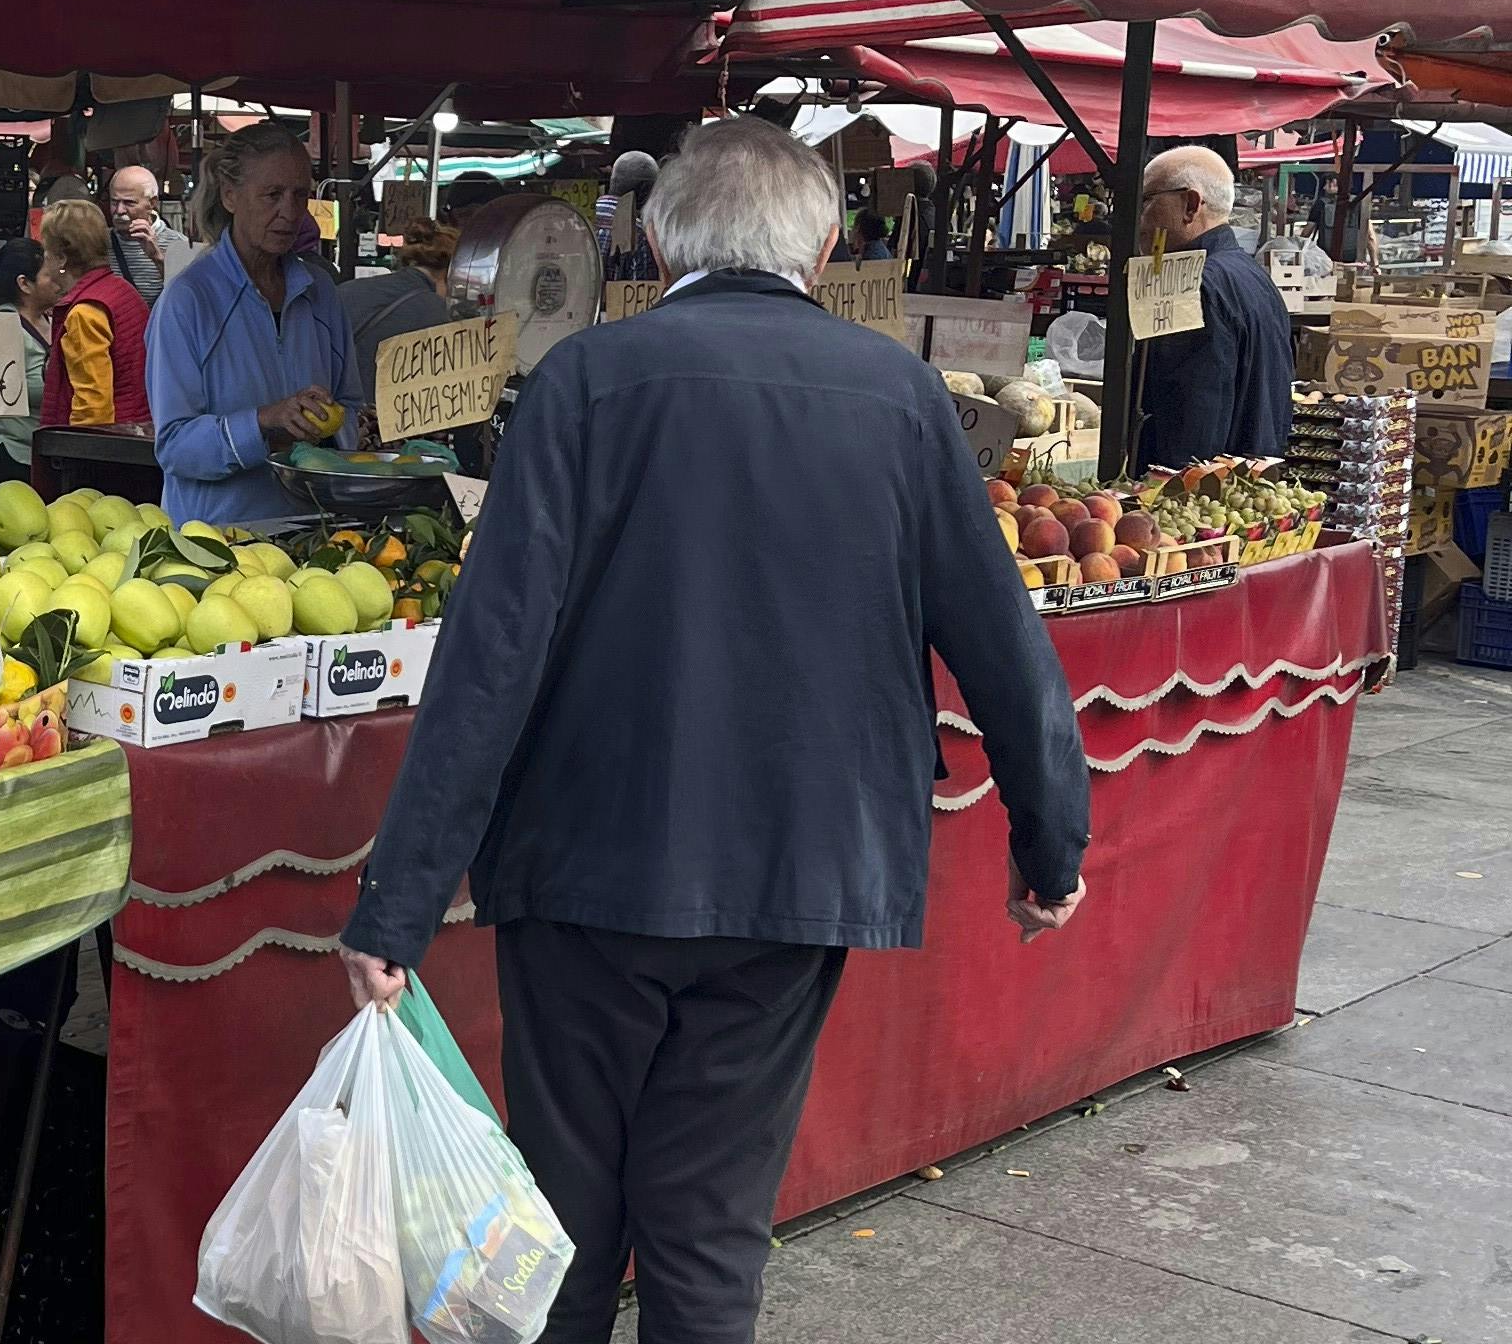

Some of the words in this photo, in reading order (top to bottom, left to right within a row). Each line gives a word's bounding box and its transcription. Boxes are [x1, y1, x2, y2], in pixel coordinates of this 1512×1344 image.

[391, 318, 498, 384] CLEMENTINE
[1419, 343, 1480, 369] BAN
[1408, 366, 1478, 394] BOM
[330, 658, 385, 685] Melinda
[156, 682, 217, 713] Melinda
[503, 1247, 545, 1296] Scelta
